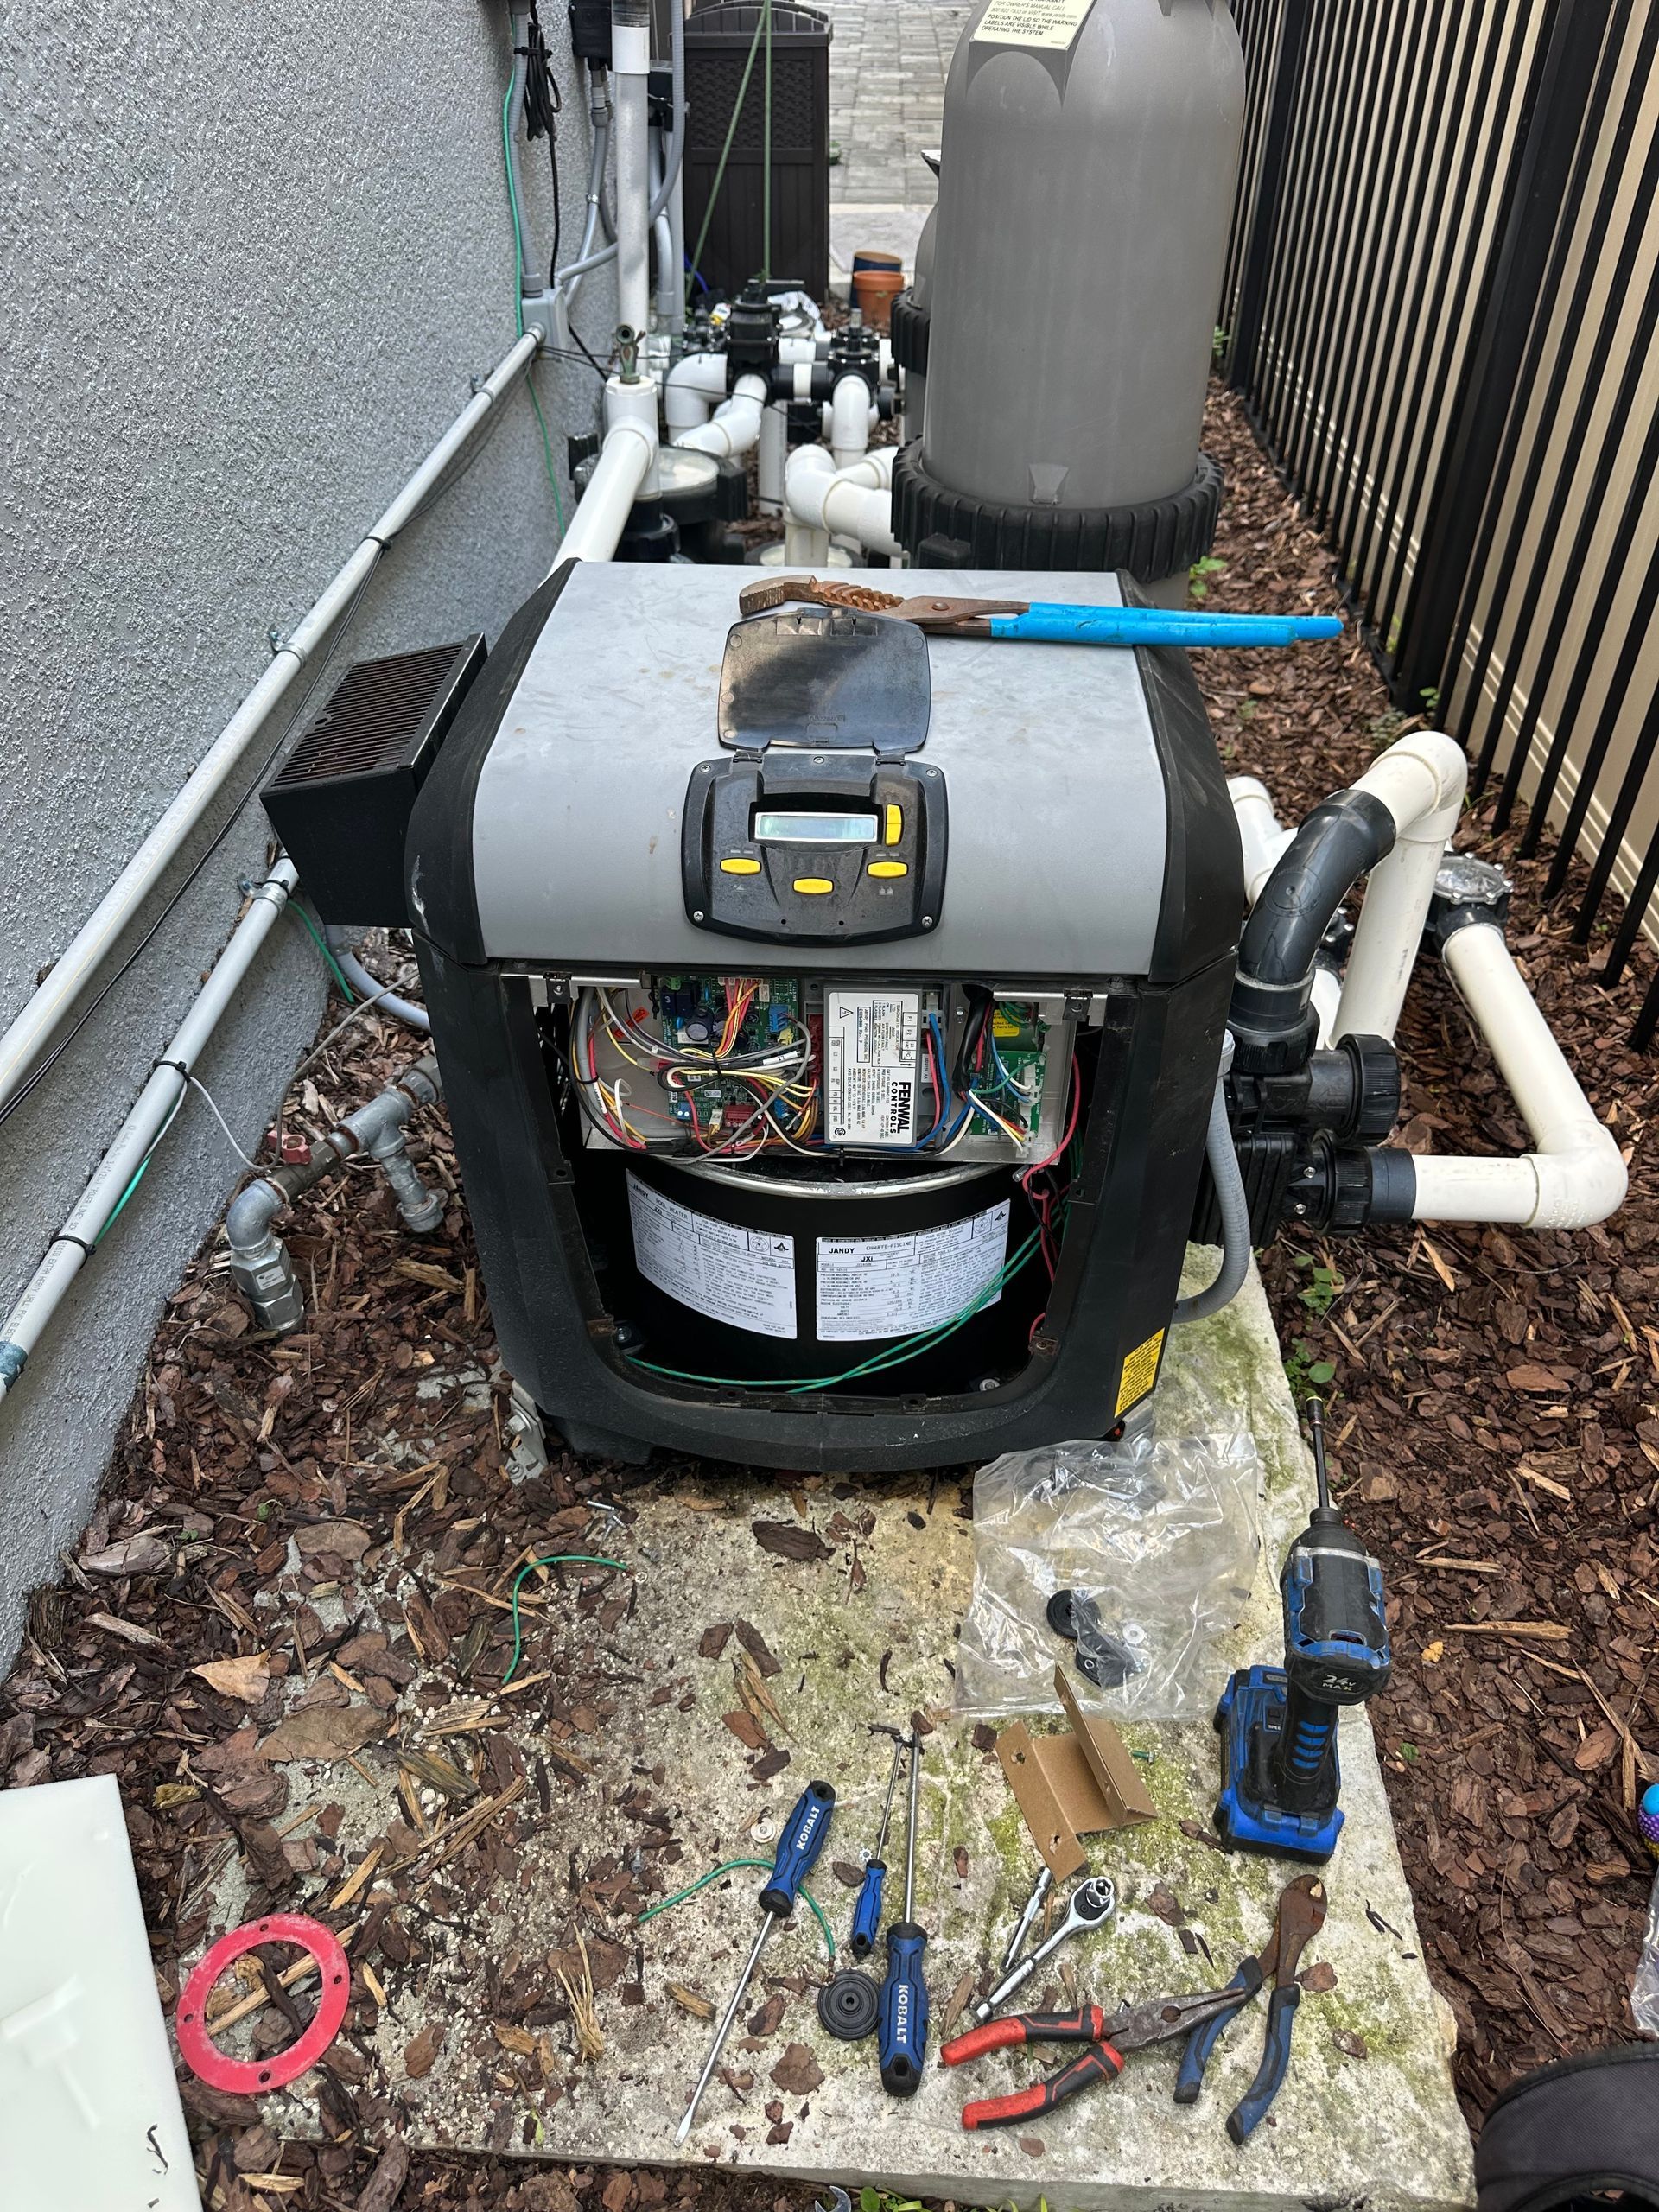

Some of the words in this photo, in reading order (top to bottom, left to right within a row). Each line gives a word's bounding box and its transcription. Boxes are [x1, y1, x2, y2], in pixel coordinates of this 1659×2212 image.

[897, 1082, 911, 1133] FENWAL
[655, 1198, 667, 1208] POOL
[669, 1206, 688, 1218] HEATER
[866, 1241, 912, 1250] CHAUFFE-PISCINE
[1322, 1683, 1353, 1691] MAX
[796, 1805, 820, 1850] KOBALT
[897, 1984, 909, 2044] KOBALT
